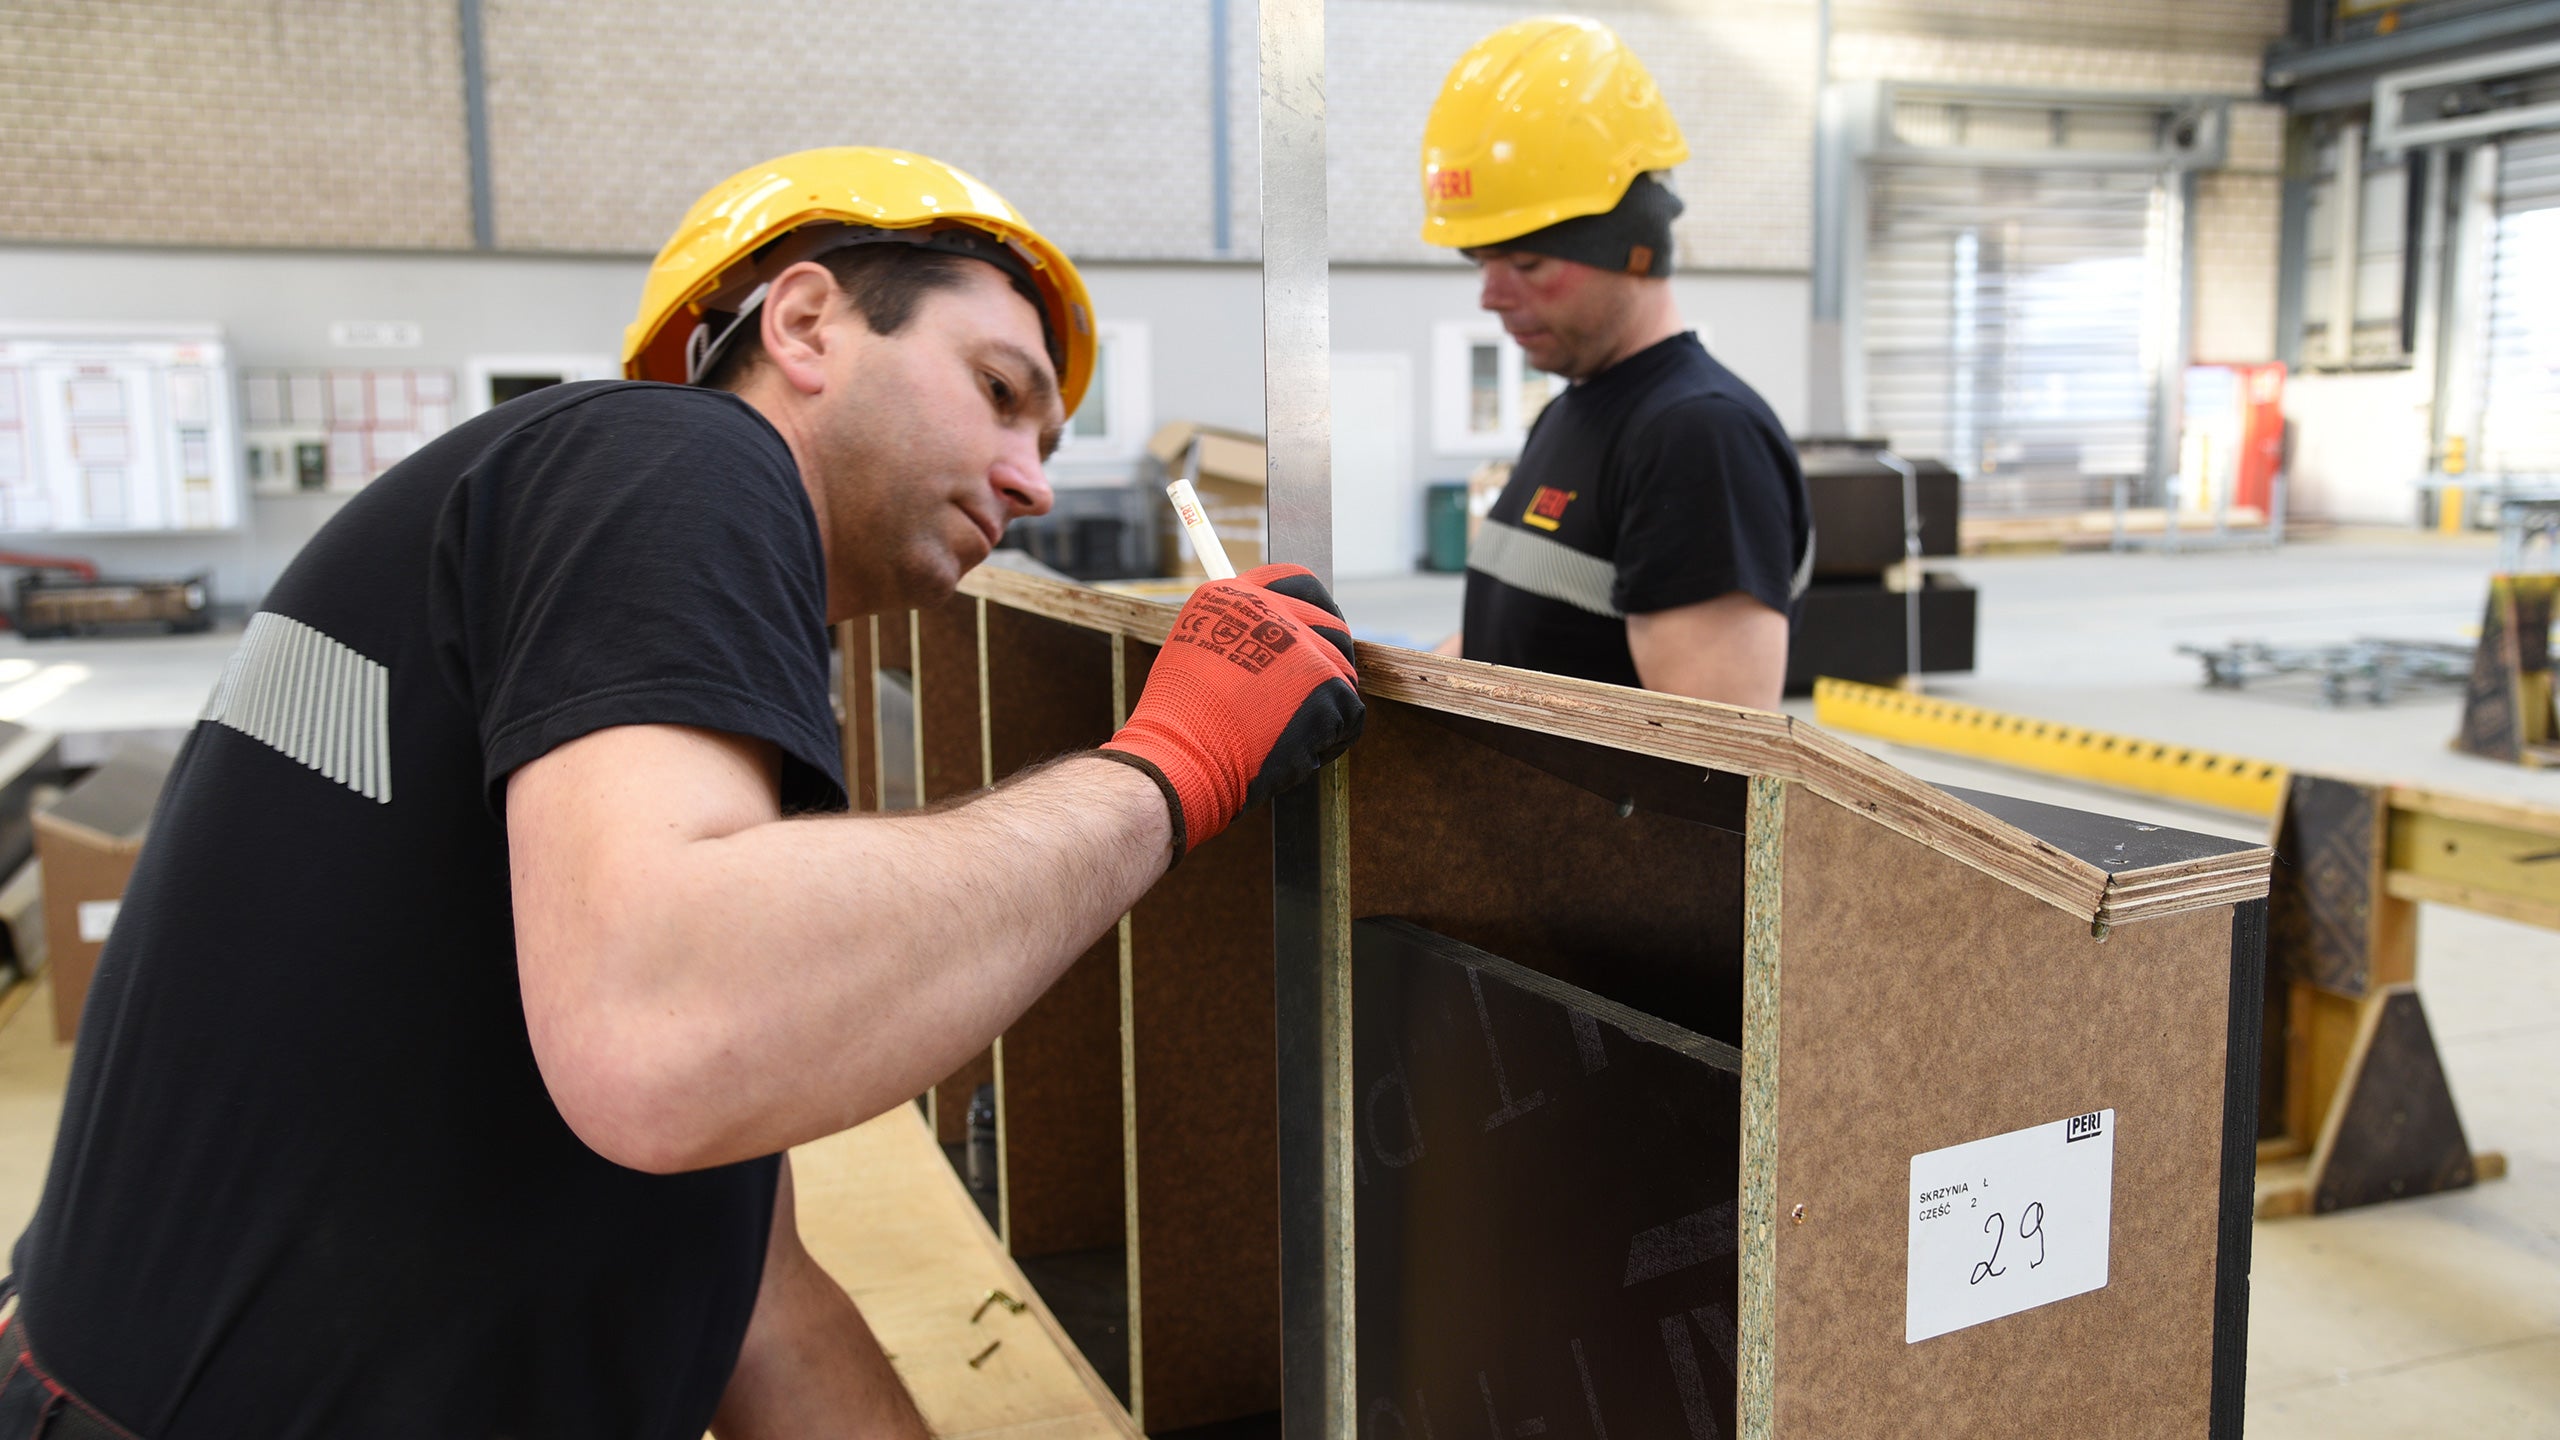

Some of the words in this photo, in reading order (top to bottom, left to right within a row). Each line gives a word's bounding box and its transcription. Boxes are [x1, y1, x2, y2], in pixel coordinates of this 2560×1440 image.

[2072, 1112, 2101, 1135] PERI
[1919, 1182, 1969, 1204] SKRZYNIA
[1983, 1178, 1989, 1188] Ł
[1919, 1203, 1951, 1222] CZĘŚĆ
[1971, 1197, 1977, 1208] 2
[1970, 1201, 2045, 1286] 29
